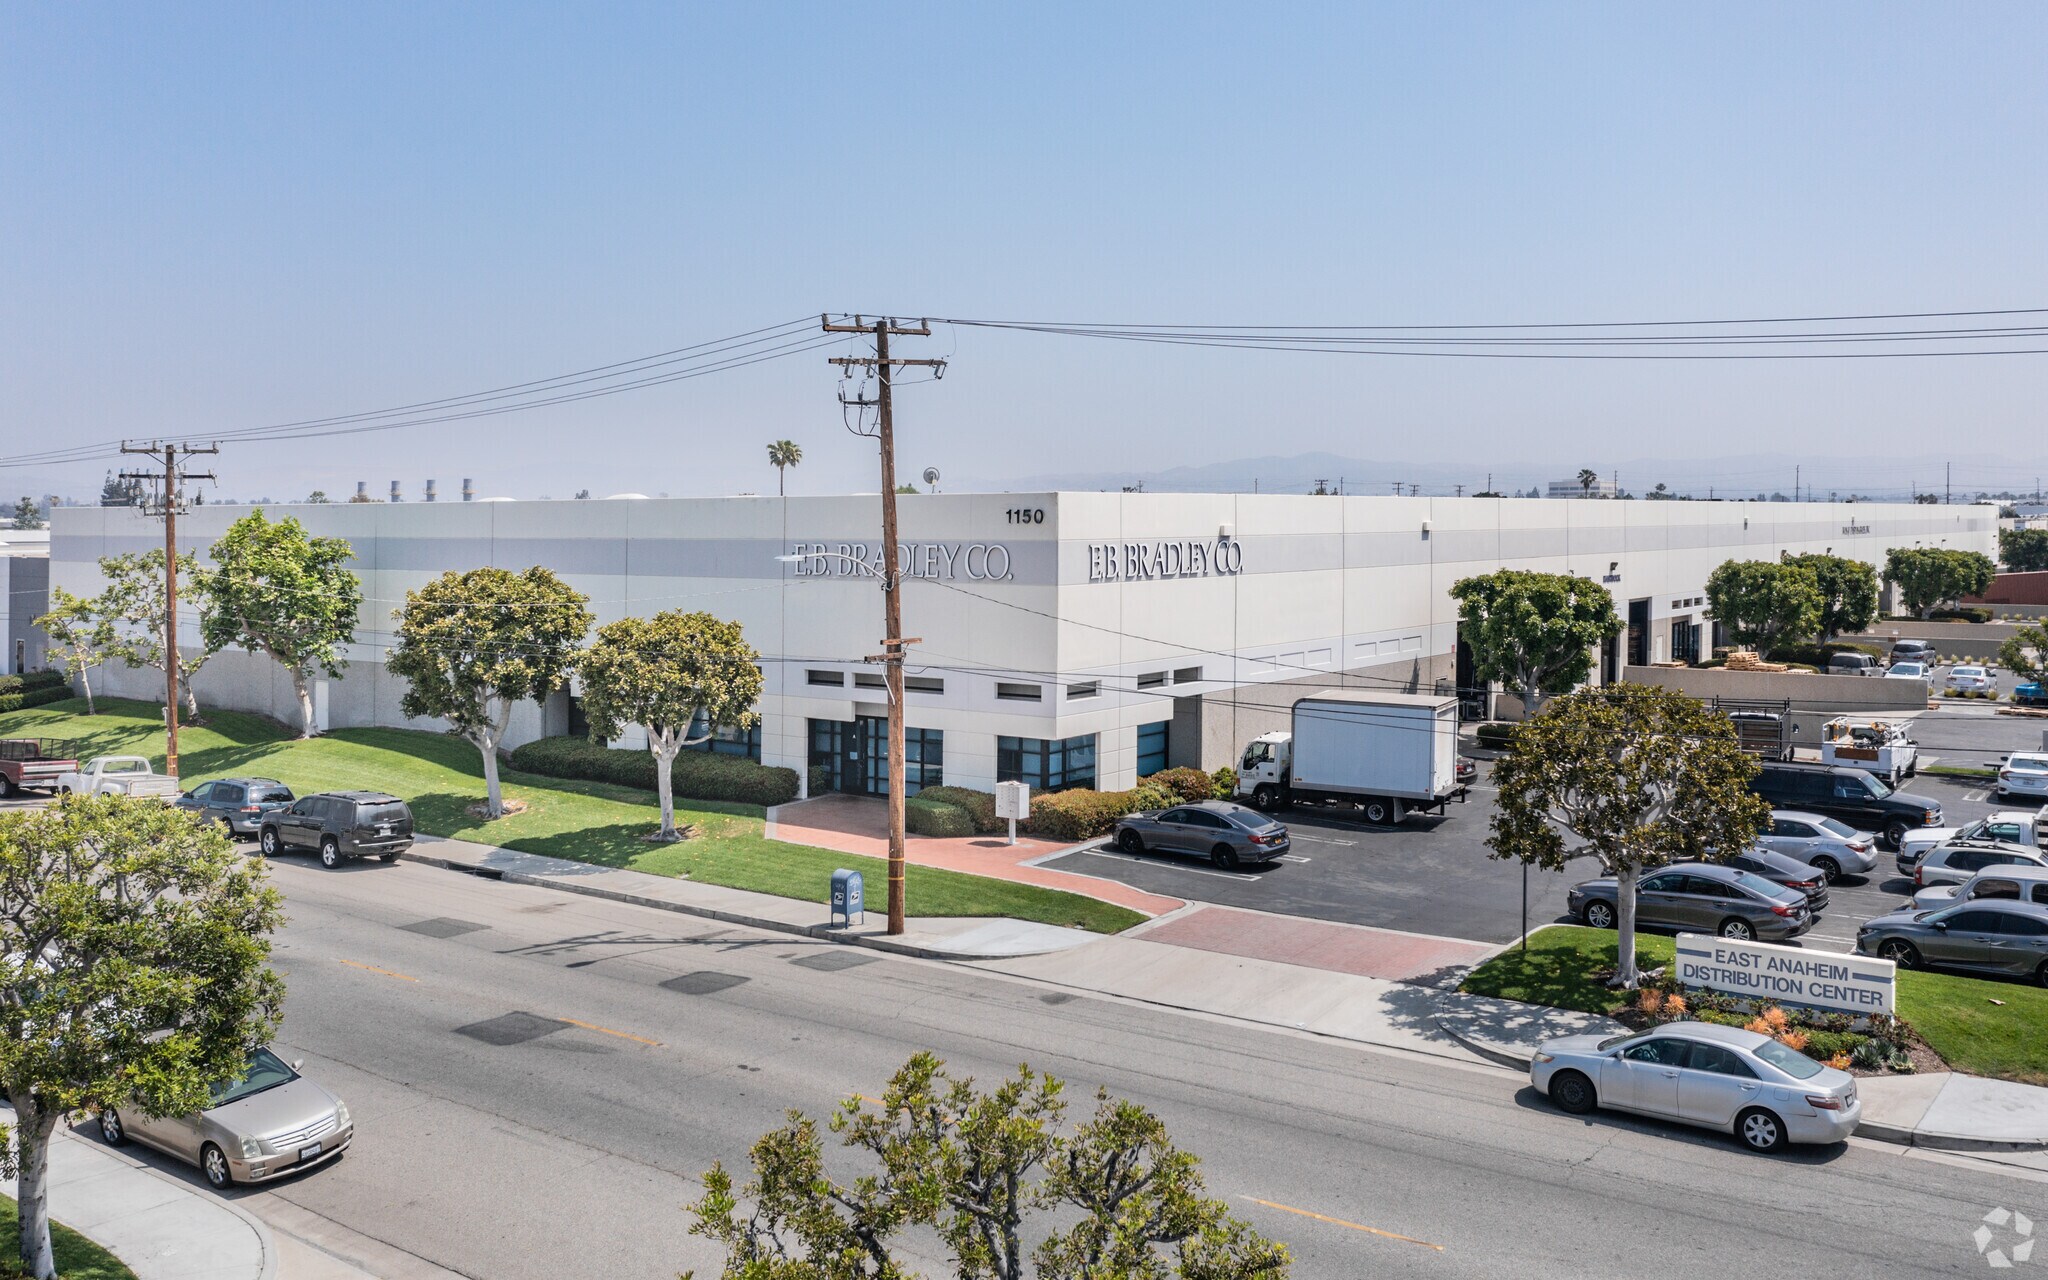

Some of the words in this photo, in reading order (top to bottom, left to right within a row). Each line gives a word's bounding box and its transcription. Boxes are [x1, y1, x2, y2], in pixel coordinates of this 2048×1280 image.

[1005, 508, 1044, 524] 1150
[793, 543, 831, 577] E.B.
[965, 544, 1014, 580] CO.
[1088, 544, 1120, 580] E.B.
[1124, 541, 1212, 577] BRADLEY
[1715, 949, 1762, 969] EAST
[1767, 957, 1848, 981] ANAHEIM
[1683, 963, 1803, 994] DISTRIBUTION
[1809, 982, 1883, 1006] CENTER
